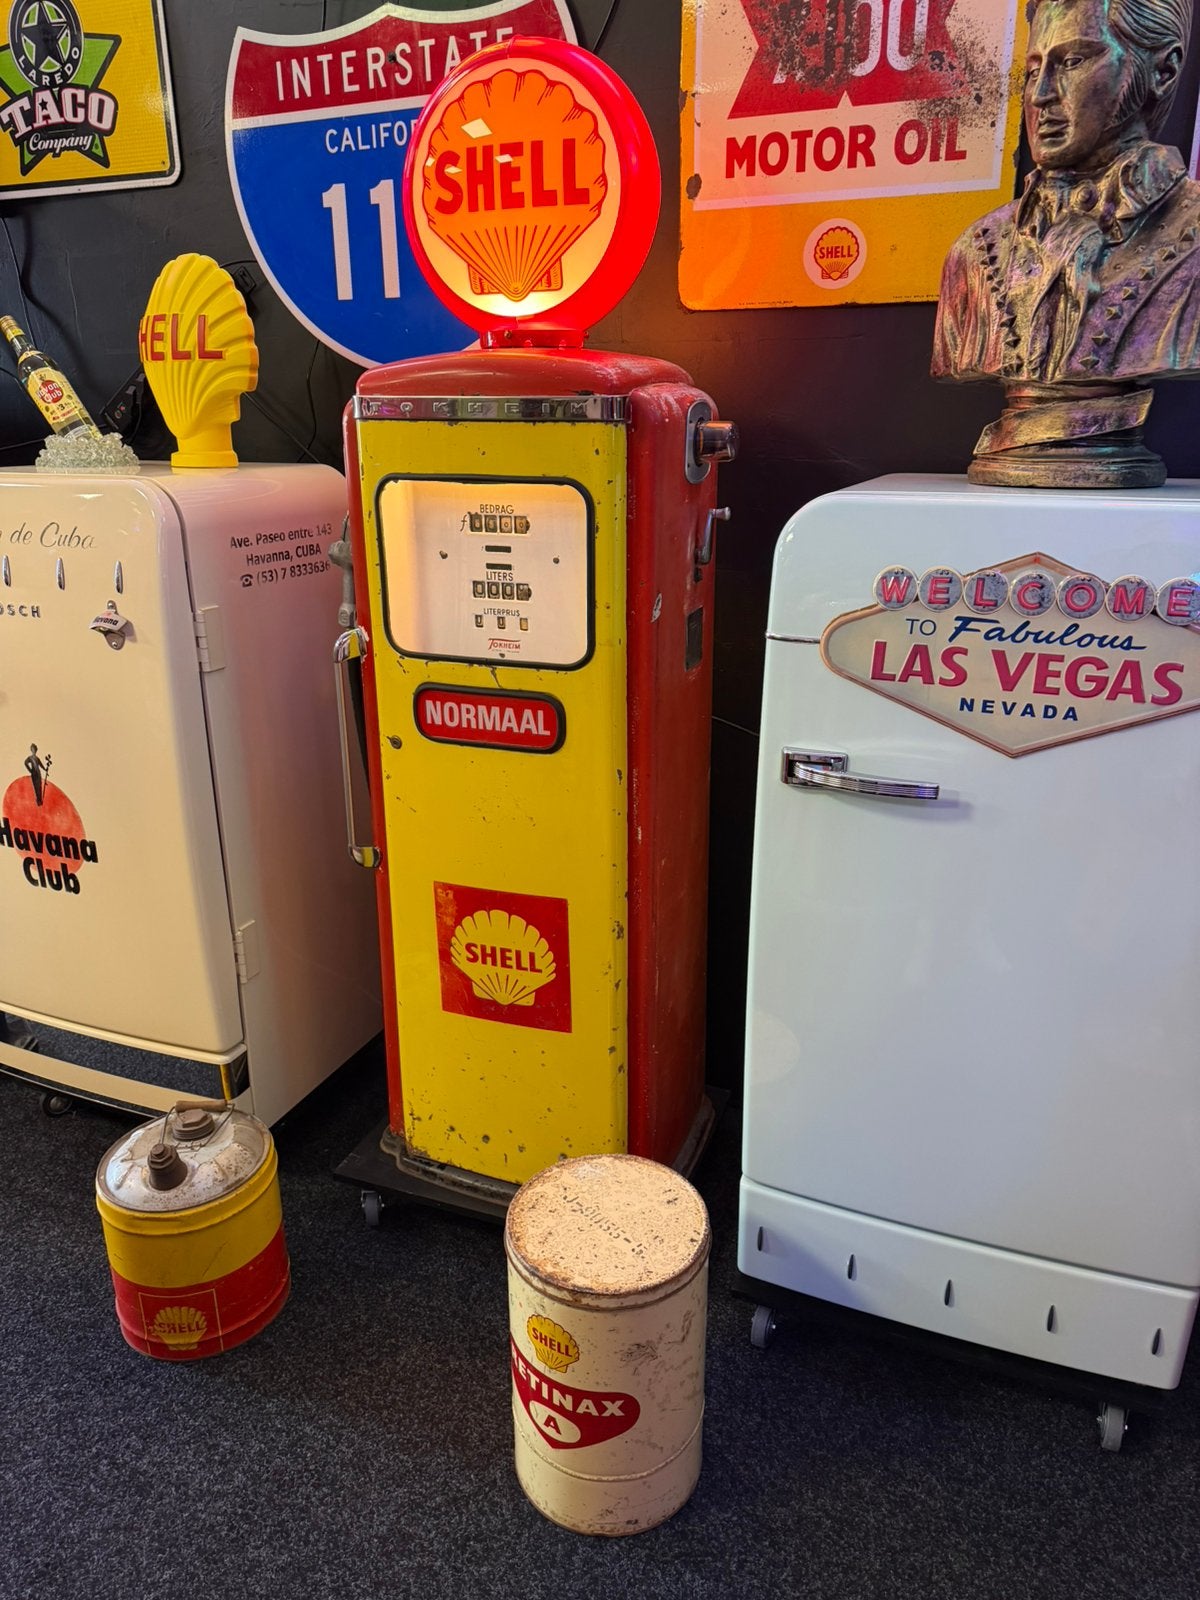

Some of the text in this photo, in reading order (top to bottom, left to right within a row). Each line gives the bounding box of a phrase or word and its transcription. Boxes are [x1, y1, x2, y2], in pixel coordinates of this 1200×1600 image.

[18, 47, 80, 86] LAREDO
[1, 87, 116, 139] TACO
[29, 132, 94, 153] Company
[725, 117, 967, 179] MOTOR OIL
[434, 138, 590, 215] SHELL
[819, 245, 854, 260] SHELL
[368, 401, 588, 417] TOKHEIM
[480, 504, 514, 515] BEDRAG
[9, 522, 33, 545] de
[40, 521, 98, 550] Cuba
[230, 535, 253, 549] Ave.
[256, 532, 286, 546] Paseo
[316, 523, 333, 536] 143
[246, 543, 322, 566] Havanna, CUBA
[257, 568, 279, 585] (53)
[281, 567, 288, 580] 7
[486, 571, 514, 582] LITERS
[880, 574, 1195, 618] WELCOME
[488, 638, 521, 650] TOKHEIM
[905, 615, 1147, 651] TO Fabulous
[870, 640, 1185, 706] LAS VEGAS
[424, 699, 551, 737] NORMAAL
[959, 697, 1079, 721] NEVADA
[0, 817, 98, 863] Havana
[23, 856, 81, 894] Club
[465, 942, 543, 974] SHELL
[158, 1320, 202, 1334] SHELL
[531, 1327, 573, 1358] SHELL
[543, 1414, 562, 1436] A
